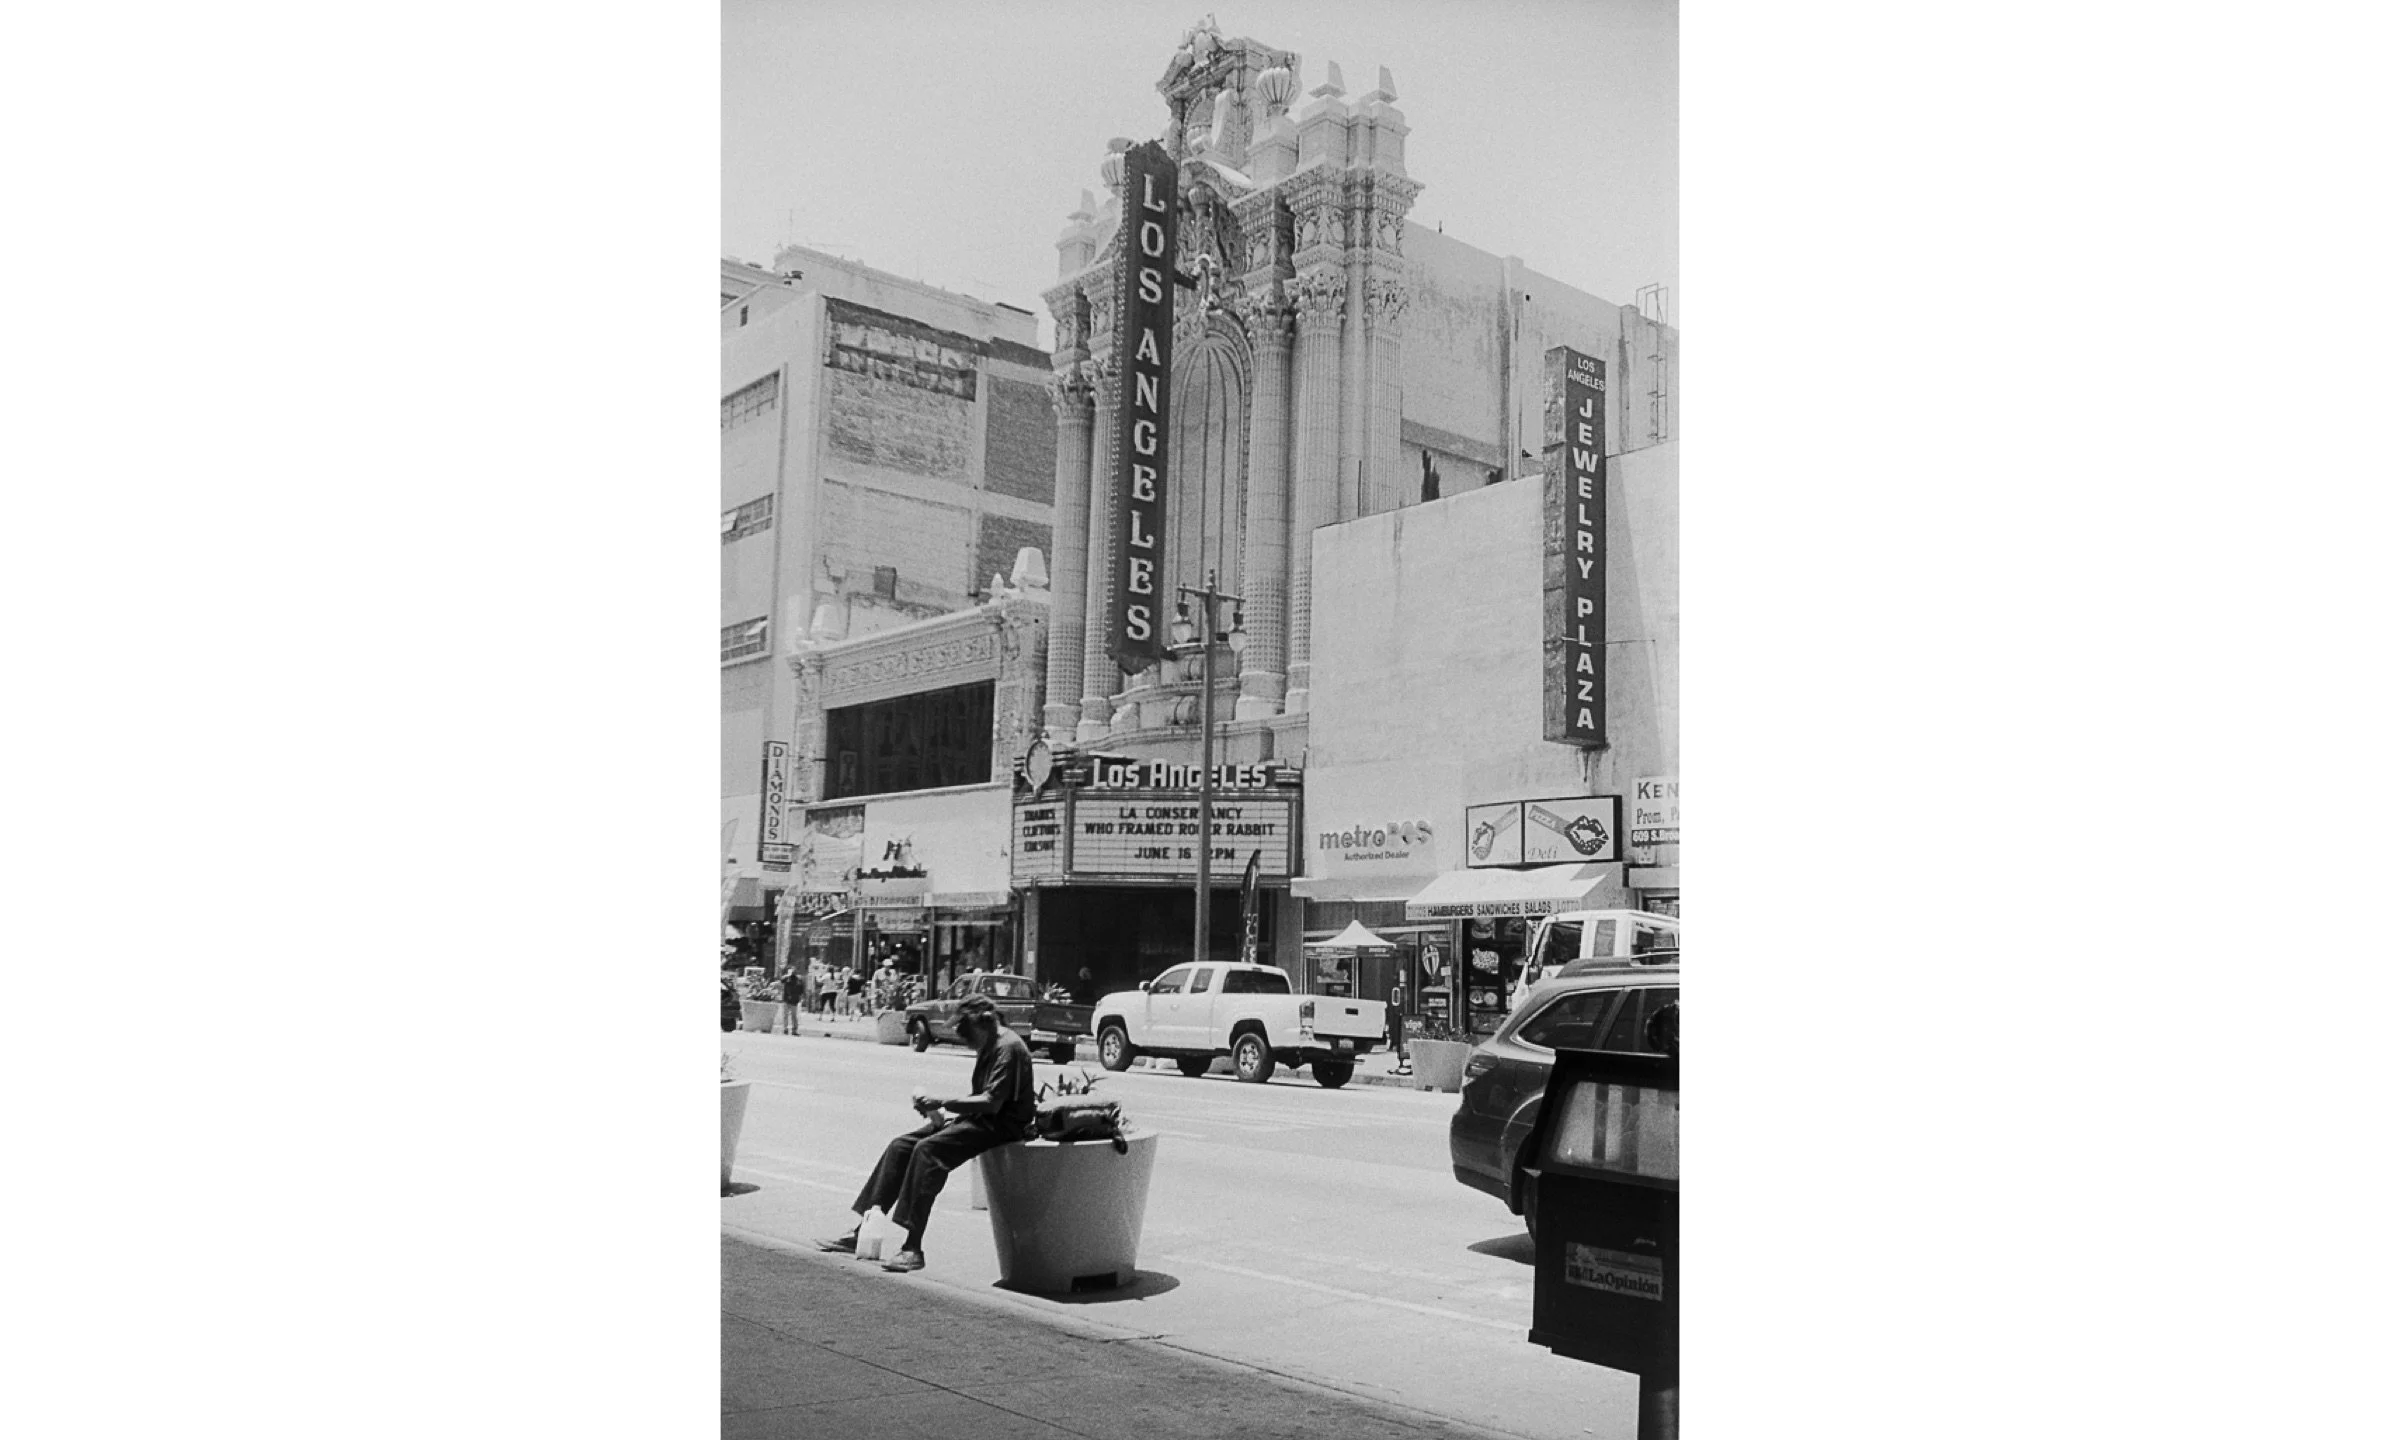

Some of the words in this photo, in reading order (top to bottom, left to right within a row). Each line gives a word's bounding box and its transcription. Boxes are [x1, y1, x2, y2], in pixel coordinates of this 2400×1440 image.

[1138, 173, 1166, 305] LOS
[1577, 357, 1595, 373] LOS
[1567, 368, 1605, 392] ANGELES
[1126, 328, 1160, 641] ANGELES
[1572, 398, 1598, 579] JEWELRY
[1576, 597, 1595, 730] PLAZA
[1119, 807, 1137, 819] LA
[1085, 823, 1113, 835] WHO
[1118, 823, 1174, 835] FRAMED
[1226, 823, 1275, 836] RABBIT
[1134, 847, 1170, 859] JUNE
[1177, 847, 1192, 859] 16
[1385, 850, 1410, 860] Dealer
[1428, 904, 1474, 917] HAMBURGERS
[1477, 902, 1520, 915] SANDWICHES
[1525, 900, 1551, 914] SALADS
